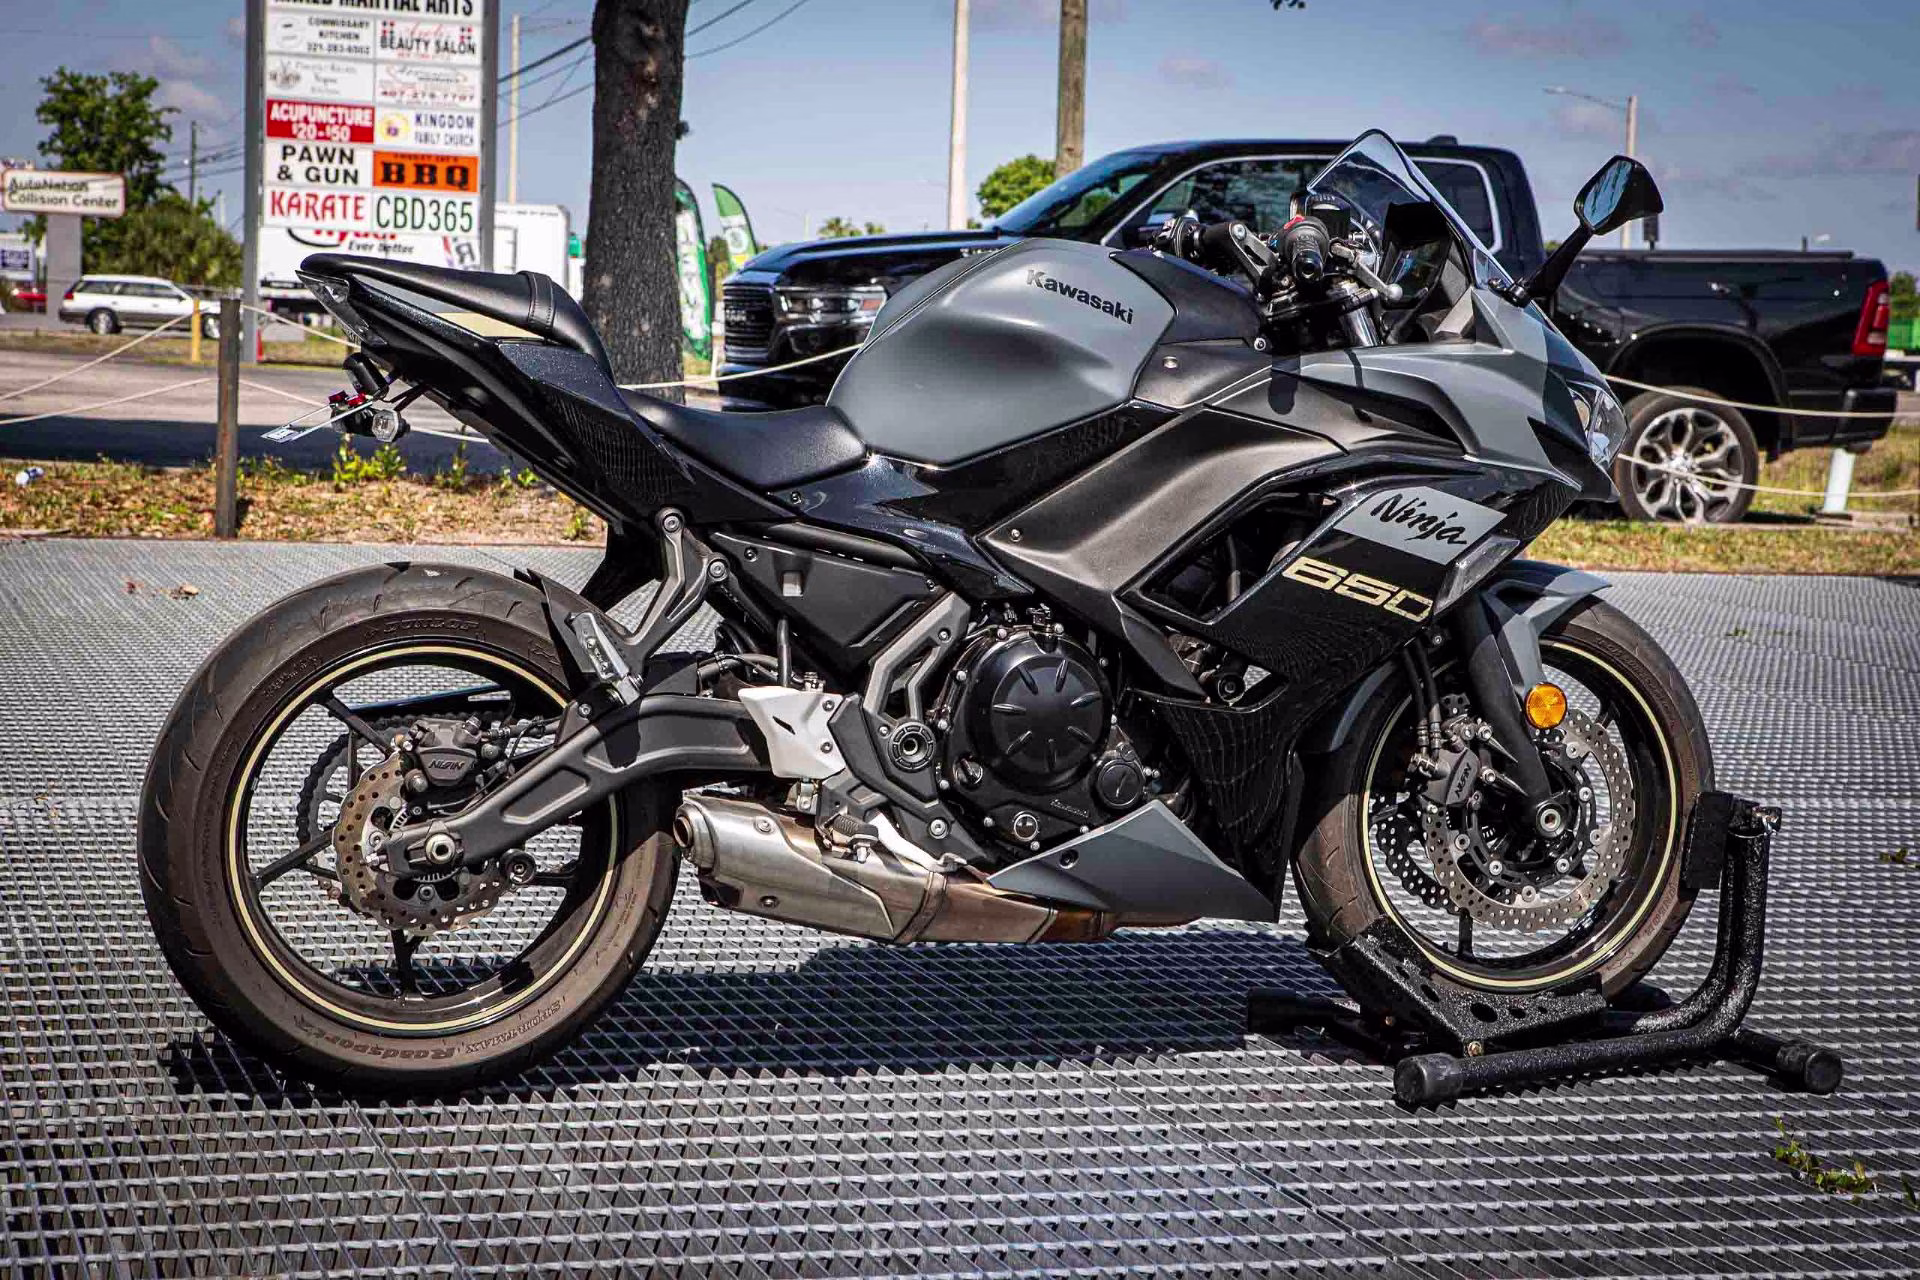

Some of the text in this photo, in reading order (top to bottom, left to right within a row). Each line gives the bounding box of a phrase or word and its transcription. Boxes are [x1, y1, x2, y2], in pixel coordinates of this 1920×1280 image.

[380, 35, 430, 52] BEAUTY
[435, 39, 476, 54] SALON
[270, 102, 373, 128] ACUPUNCTURE
[415, 112, 474, 129] KINGDOM
[282, 145, 355, 165] PAWN
[277, 165, 359, 185] & GUN
[381, 163, 469, 191] BBQ
[9, 192, 118, 208] Collision Center
[270, 191, 365, 221] KARATE
[376, 195, 473, 233] CBD365
[1026, 269, 1134, 325] Kawasaki
[1369, 493, 1467, 545] Ninja
[1281, 556, 1434, 623] 650
